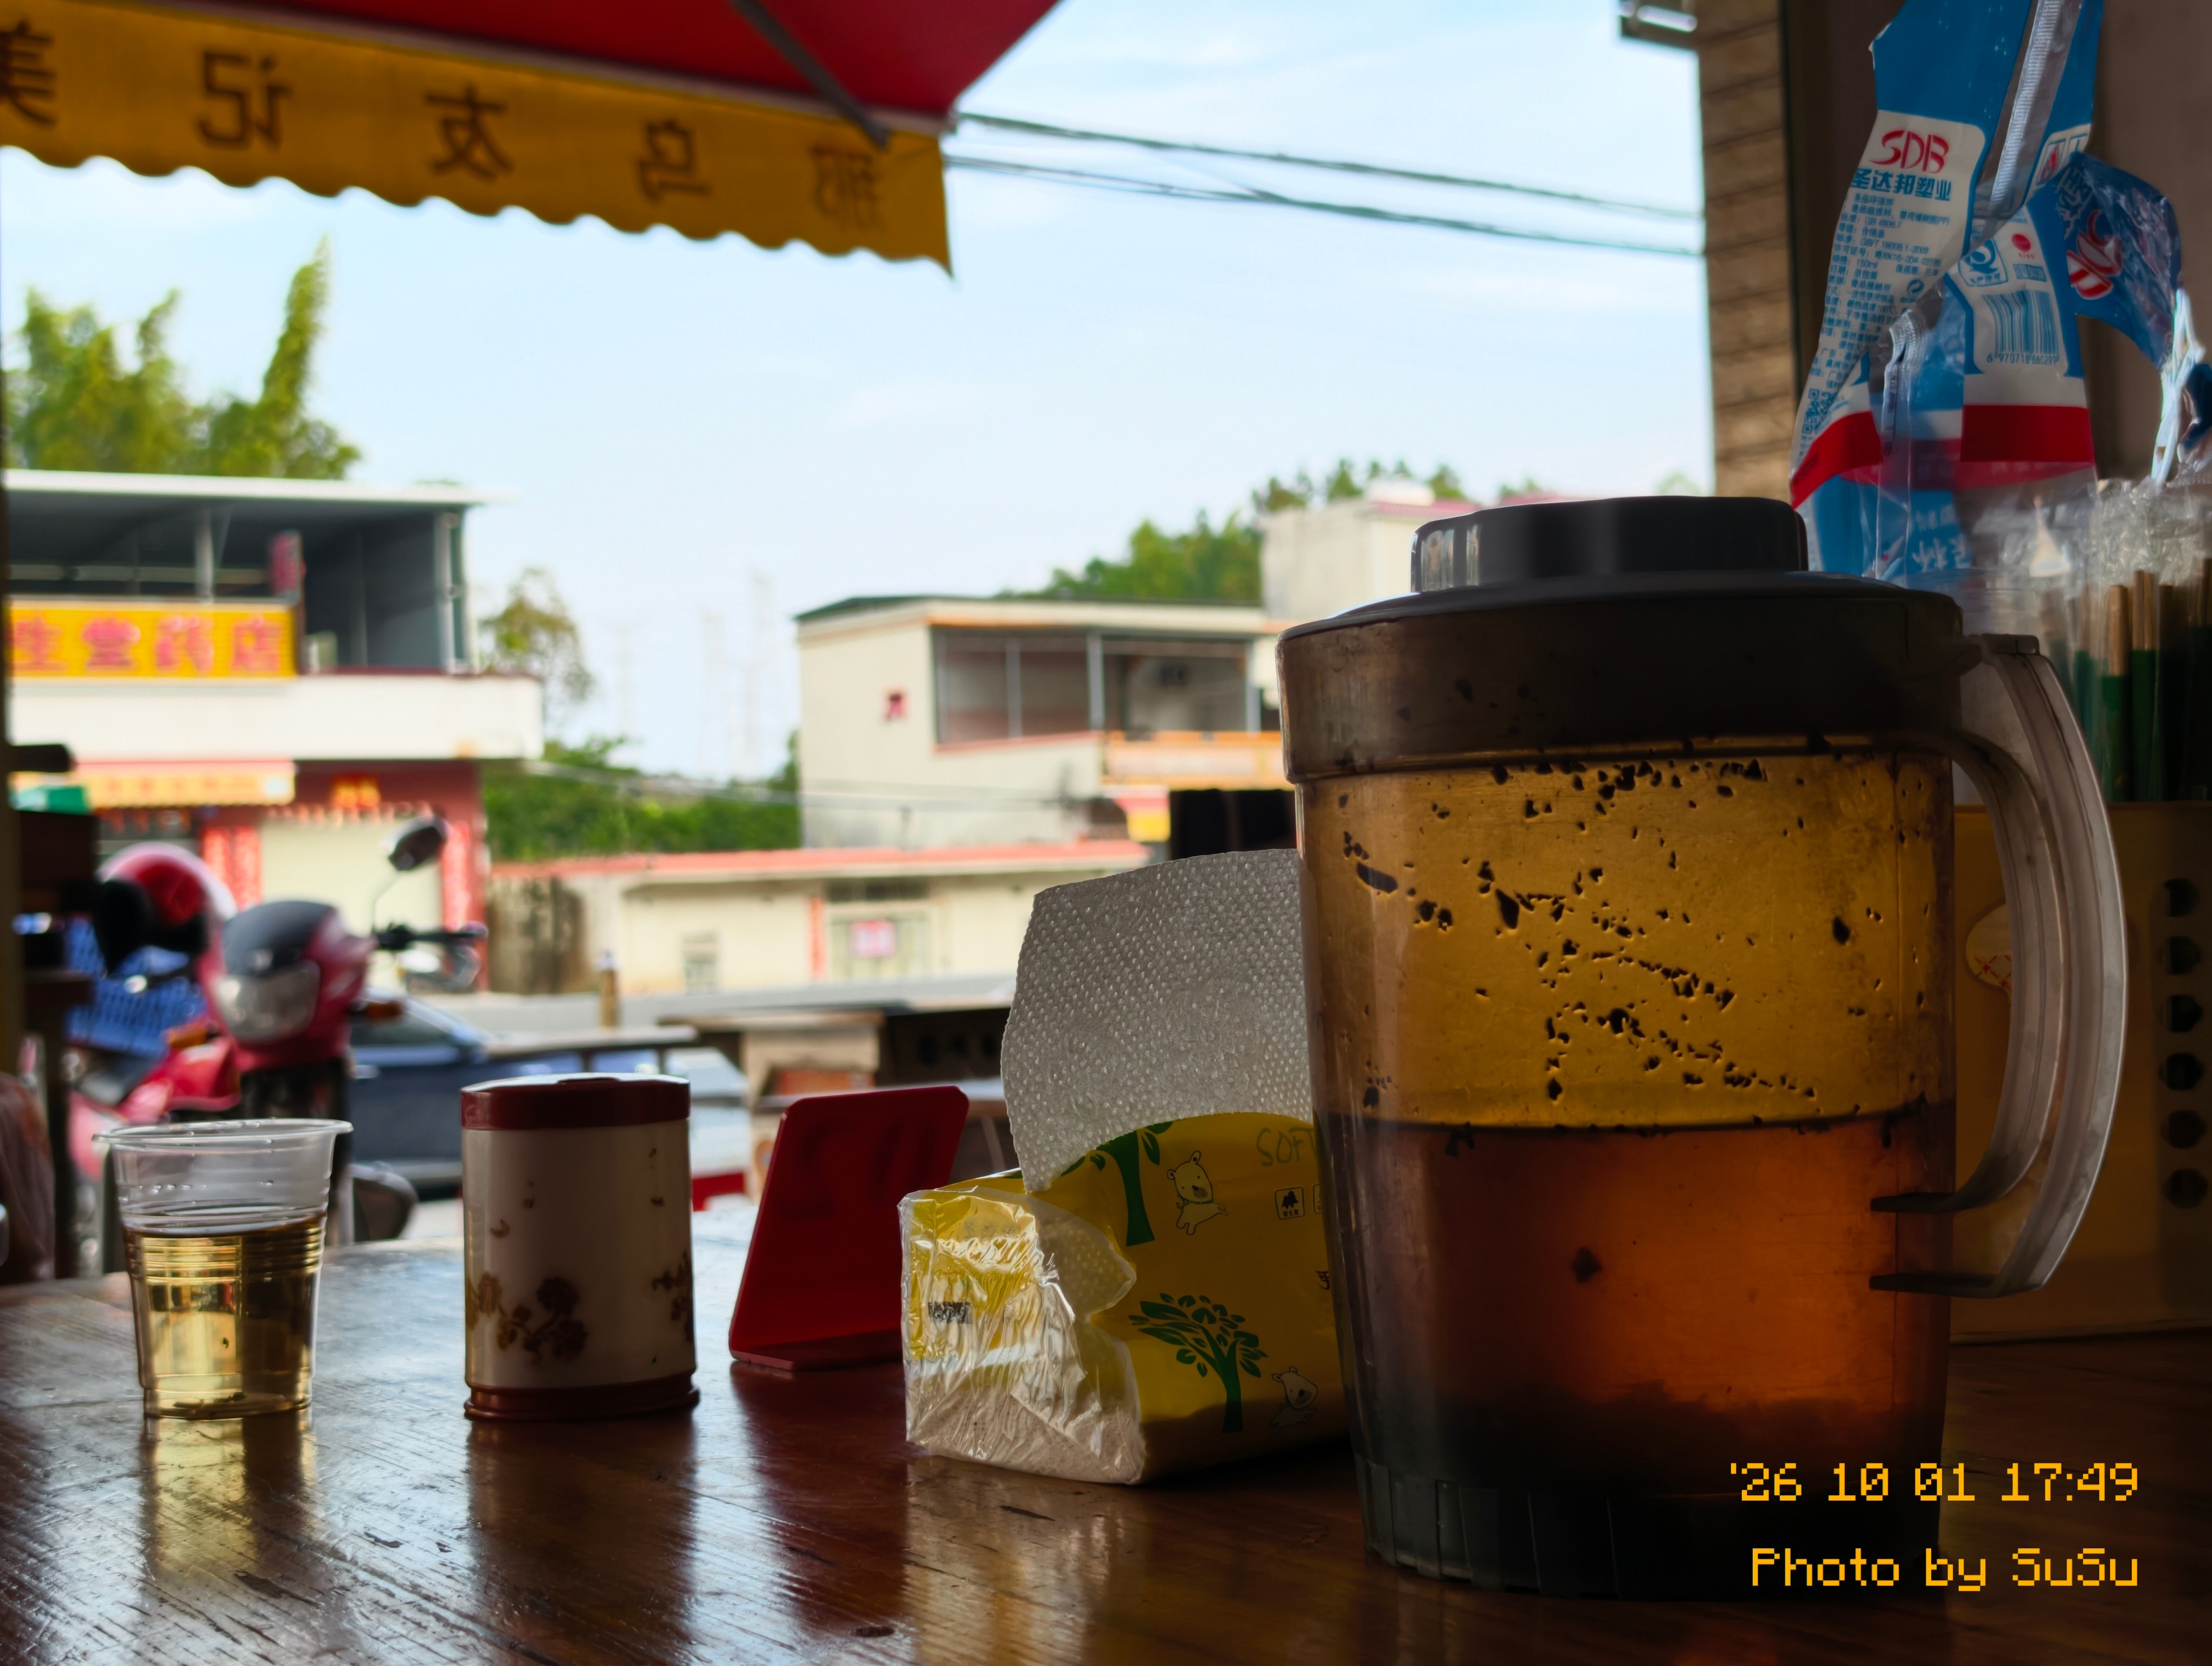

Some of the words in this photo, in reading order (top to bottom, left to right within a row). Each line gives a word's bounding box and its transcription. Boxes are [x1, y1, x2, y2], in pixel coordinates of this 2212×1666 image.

[1868, 129, 1950, 174] SDB
[1850, 167, 1952, 202] 圣达邦塑业
